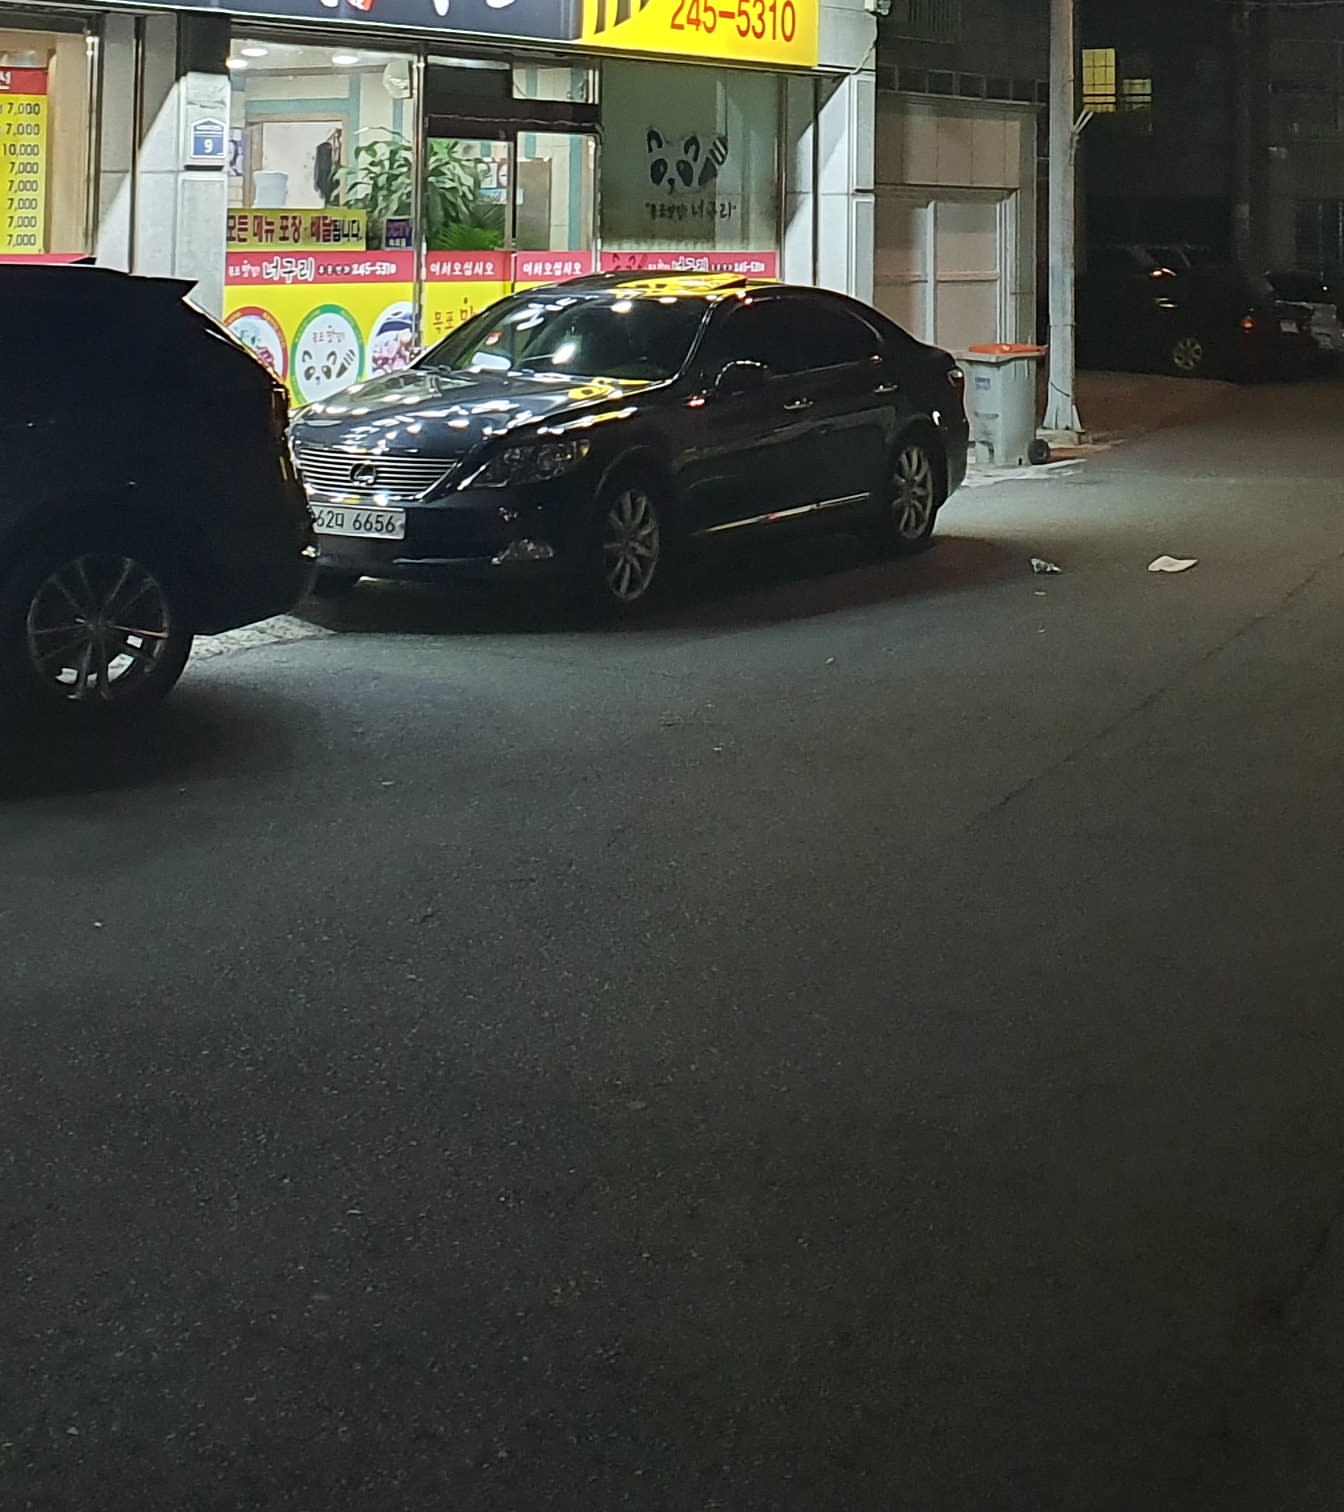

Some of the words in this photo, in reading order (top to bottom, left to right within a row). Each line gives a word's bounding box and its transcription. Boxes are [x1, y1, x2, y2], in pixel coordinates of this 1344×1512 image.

[6, 101, 41, 116] 7,000
[5, 122, 41, 137] 7,000
[2, 143, 40, 157] 10,000
[203, 138, 214, 154] 9
[8, 161, 40, 176] 7,000
[8, 179, 39, 194] 7,000
[7, 197, 38, 212] 7,000
[6, 215, 38, 230] 7,000
[278, 214, 303, 244] 포장
[6, 234, 37, 248] 7,000
[261, 255, 316, 284] 너구리
[351, 261, 397, 276] 245-5310
[429, 259, 495, 277] 어서오십시오
[522, 260, 582, 276] 어서오십시오
[352, 512, 396, 534] 6656
